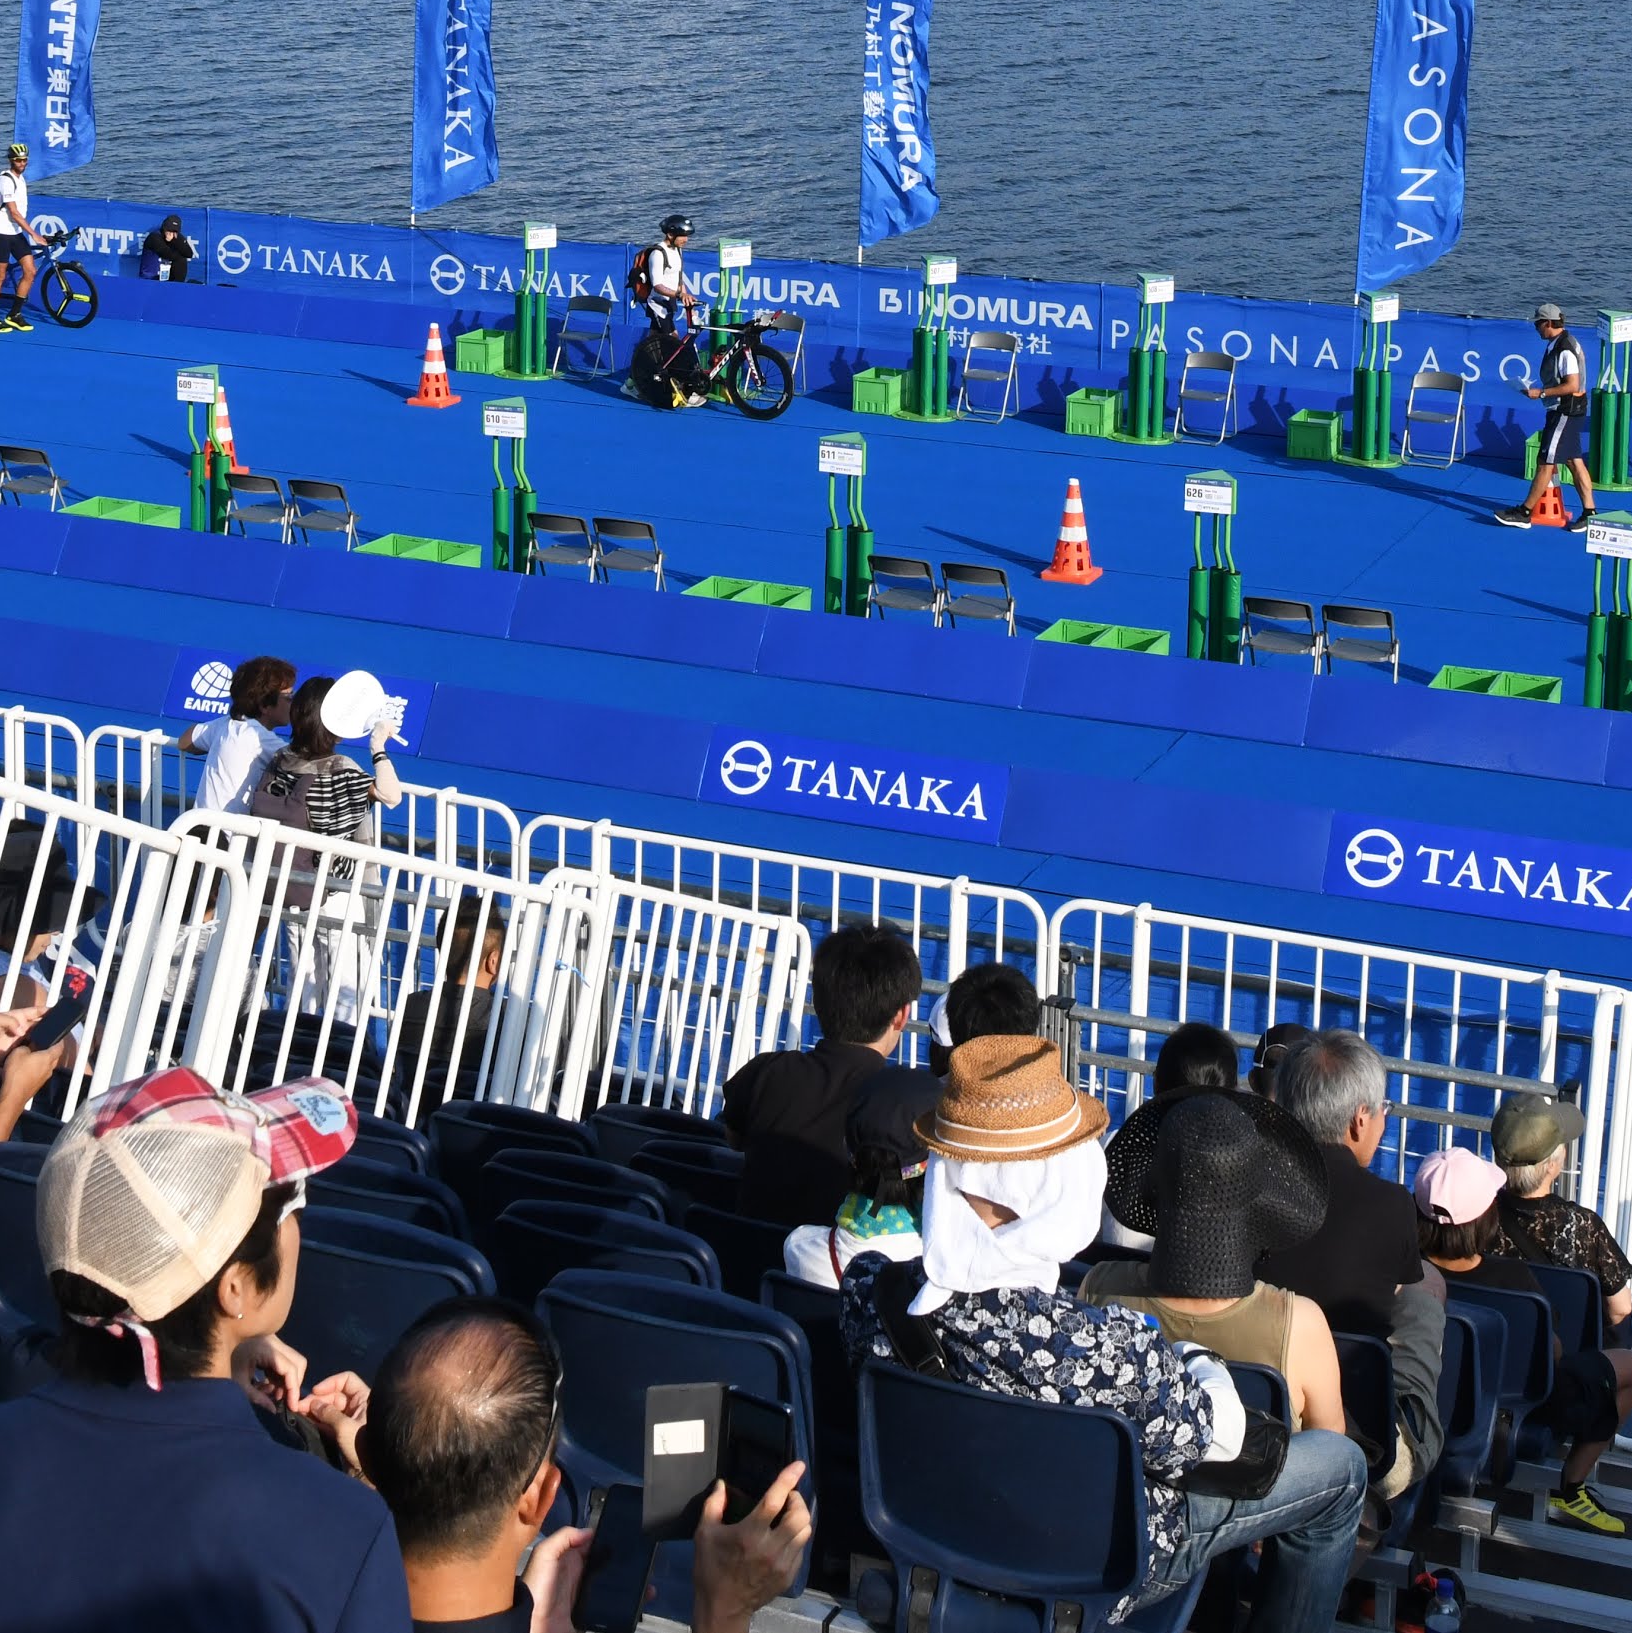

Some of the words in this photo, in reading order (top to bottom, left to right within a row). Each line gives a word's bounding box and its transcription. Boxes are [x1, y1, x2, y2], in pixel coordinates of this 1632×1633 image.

[889, 1, 924, 193] NOMURA
[257, 244, 396, 282] TANAKA
[918, 290, 1094, 331] NOMURA
[1383, 342, 1621, 392] PASOA
[178, 380, 192, 389] 609
[485, 414, 500, 424] 610
[820, 449, 836, 460] 611
[1186, 487, 1203, 498] 626
[1589, 529, 1606, 540] 627
[183, 696, 230, 715] EARTH
[782, 755, 988, 821] TANAKA
